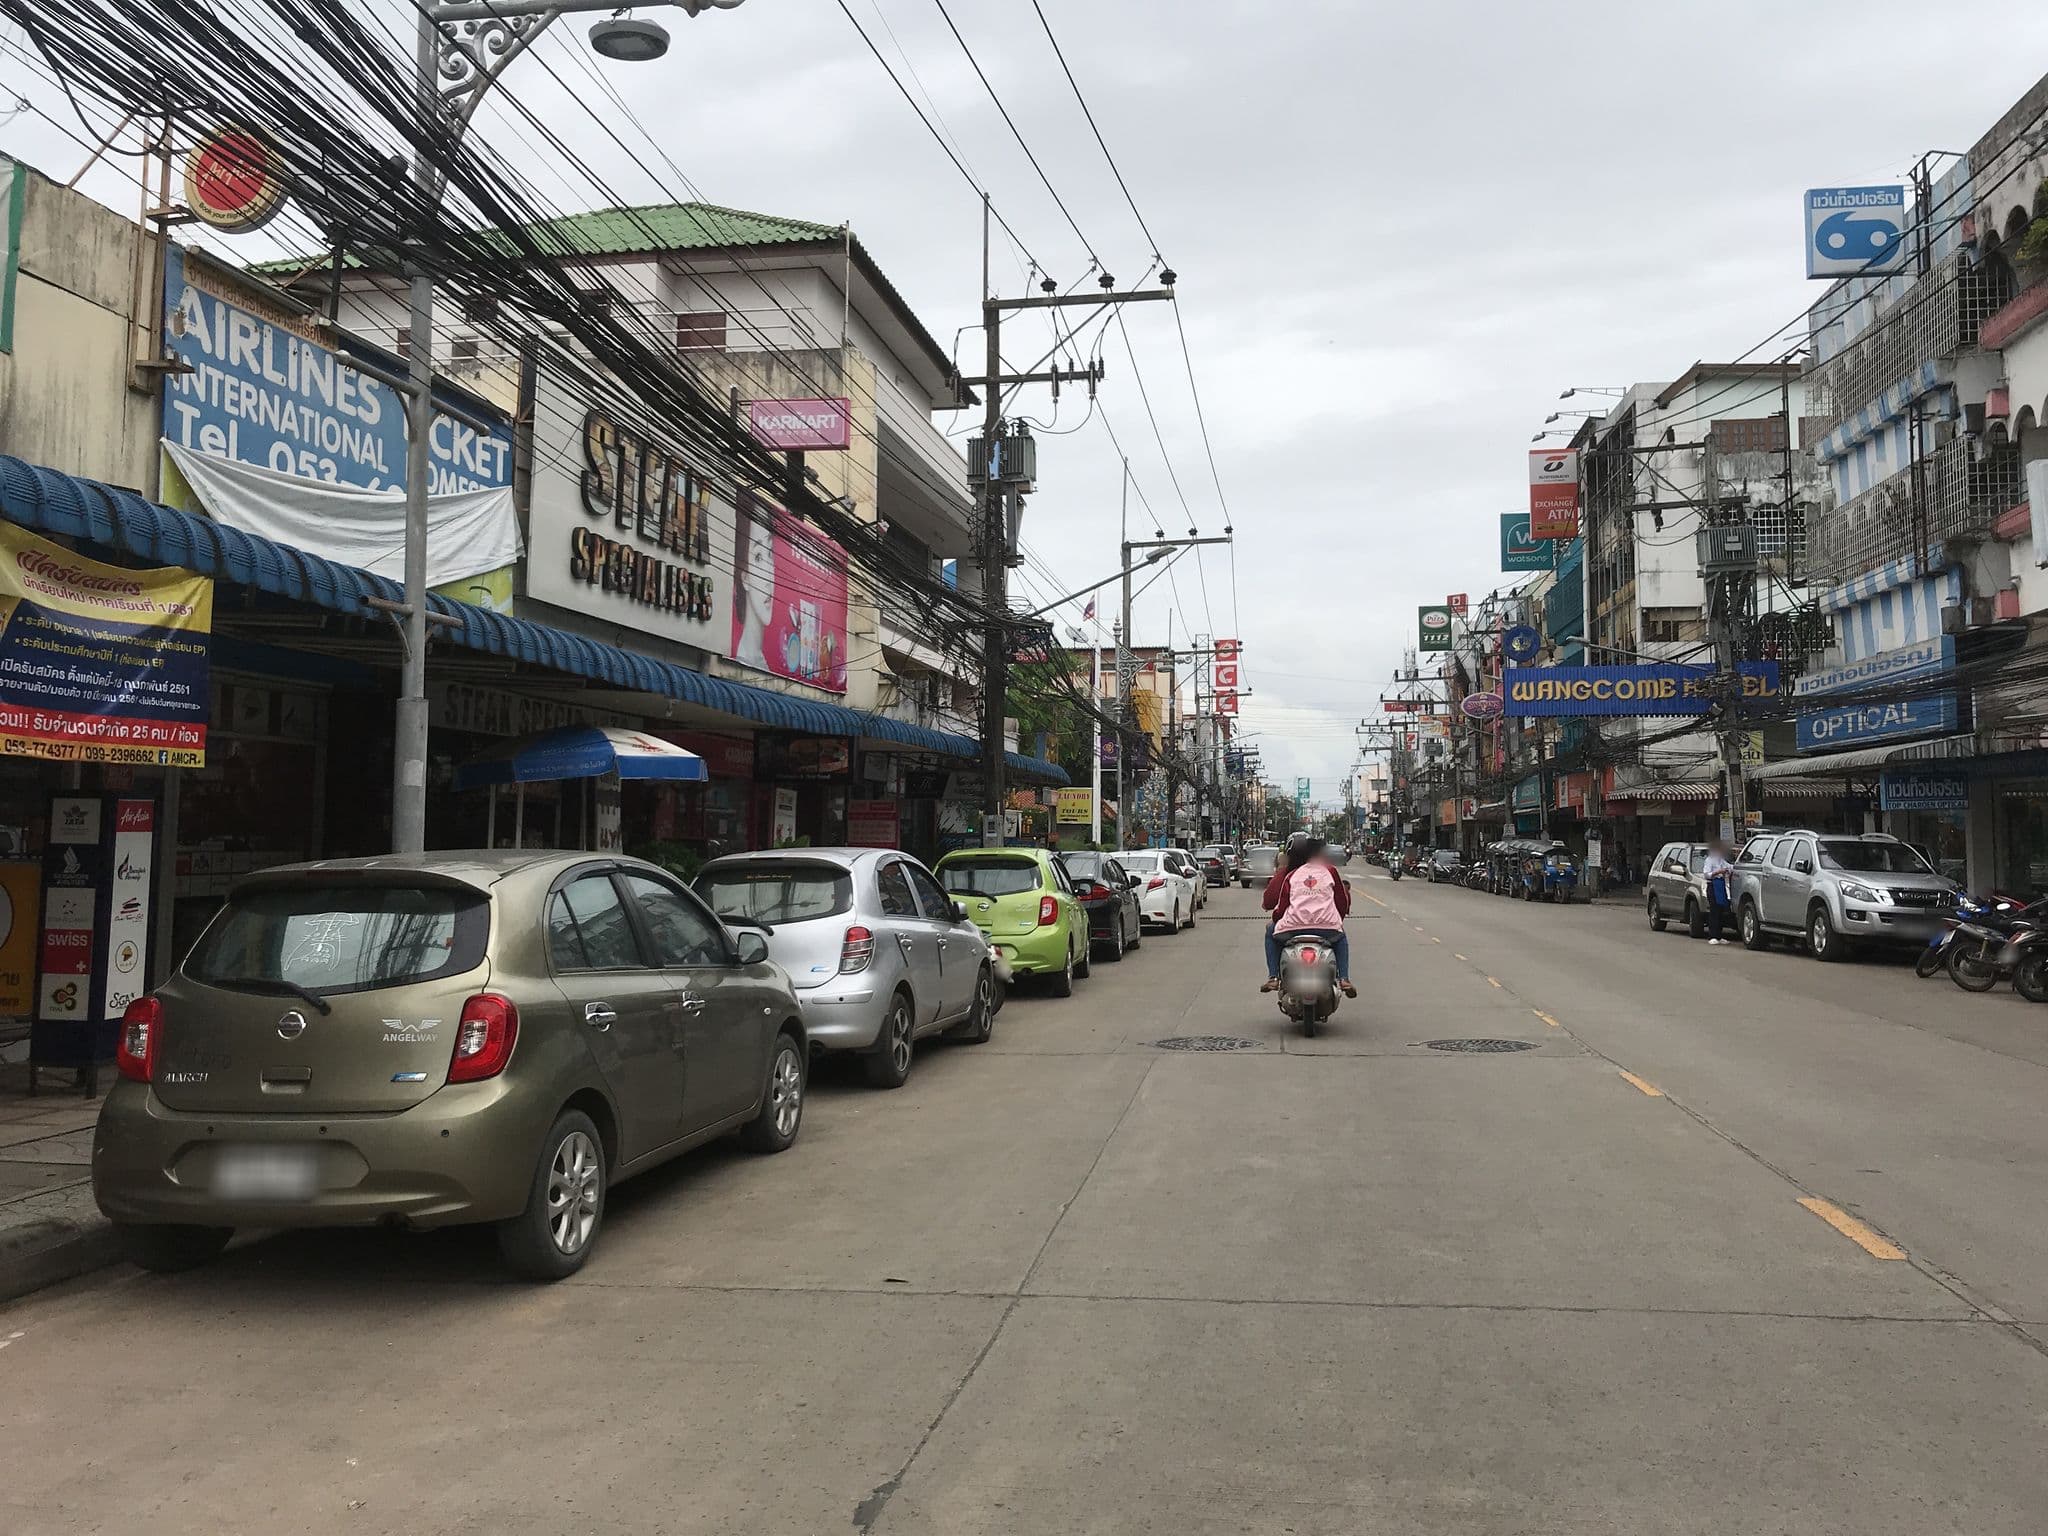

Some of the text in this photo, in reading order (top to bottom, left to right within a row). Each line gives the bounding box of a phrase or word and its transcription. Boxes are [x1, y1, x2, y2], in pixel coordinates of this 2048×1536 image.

[1813, 189, 1899, 208] แว่นท็อปเจริญ
[166, 286, 381, 426] AIRLINES
[758, 413, 839, 431] KARMART
[1535, 500, 1574, 508] EXCHANGE
[1548, 508, 1575, 520] ATM
[1507, 555, 1548, 563] watsons
[16, 550, 142, 595] เปิดรับสมัคร
[570, 526, 714, 622] SPECIALISTS
[23, 574, 85, 603] นักเรียนใหม่
[1424, 634, 1449, 642] 1112
[0, 658, 66, 680] เปิดรับสมัคร
[1512, 677, 1676, 701] WANGCOME
[1811, 701, 1917, 740] OPTICAL
[132, 725, 149, 739] 25
[151, 727, 169, 741] คน
[178, 726, 199, 744] ห้อง
[1887, 800, 1966, 809] TOP CHAROEN OPTICAL
[47, 932, 88, 947] swiss
[382, 1033, 439, 1043] ANGELWAY
[164, 1072, 210, 1083] MARCH
